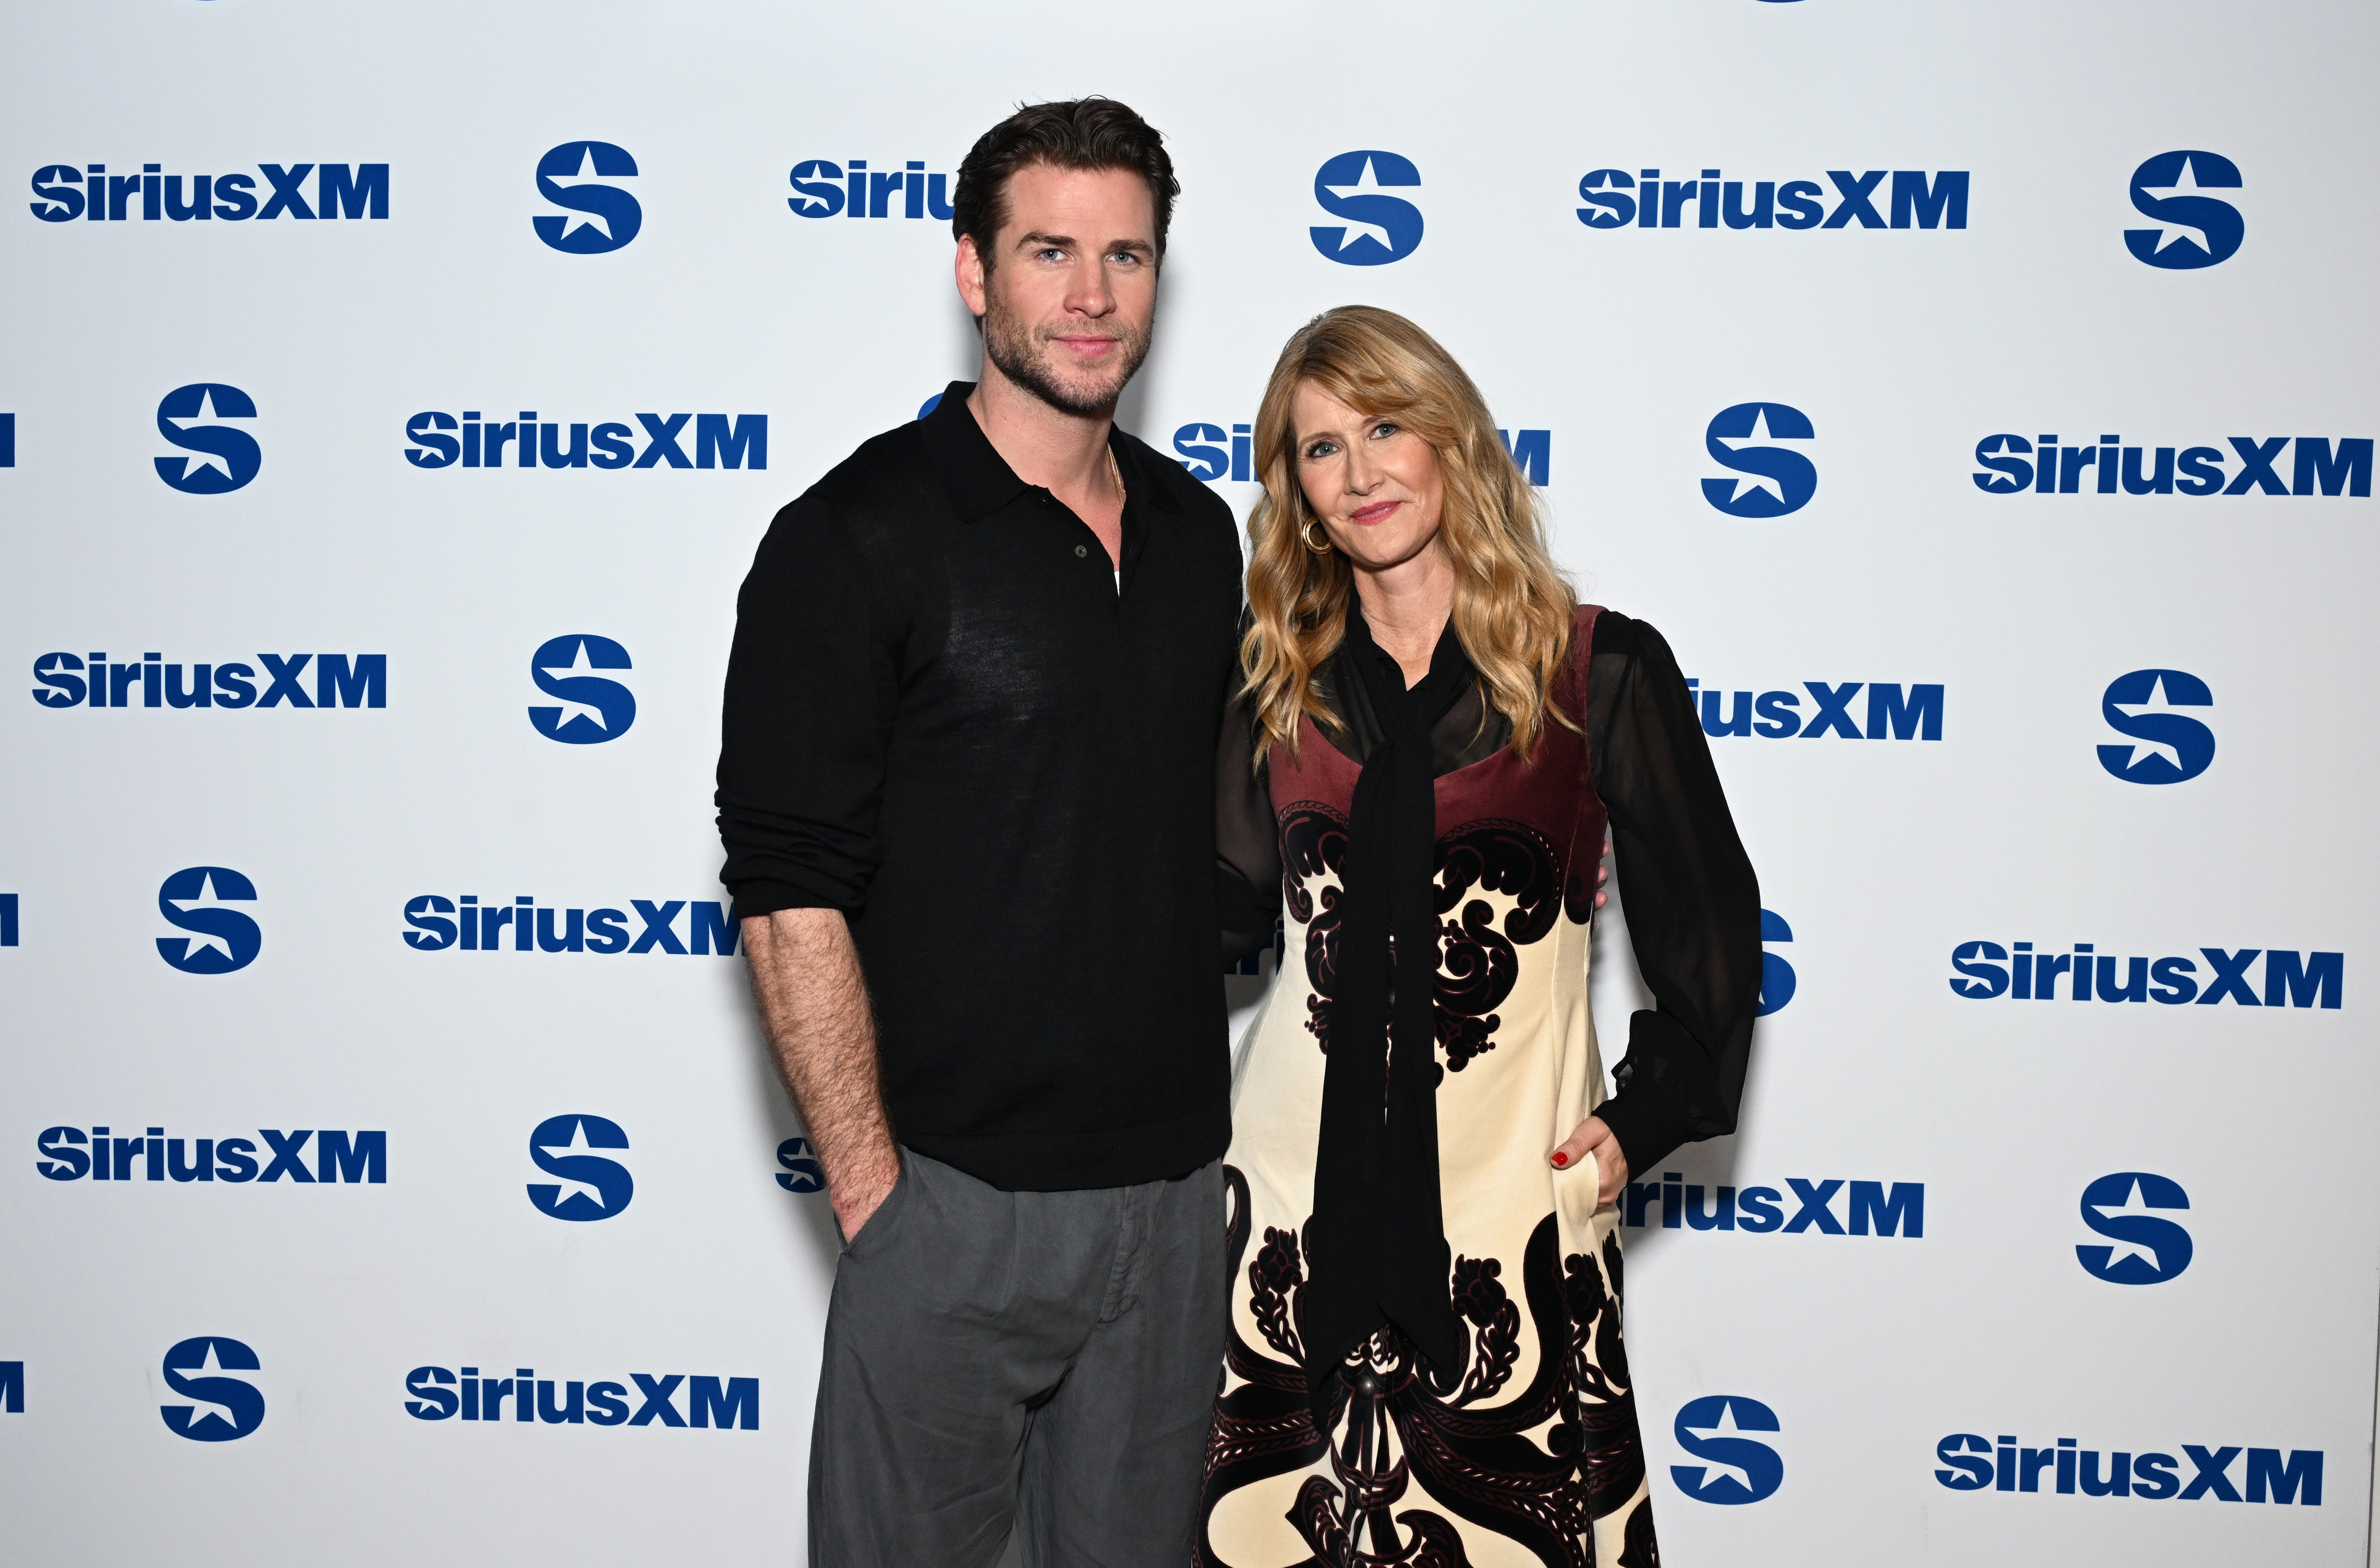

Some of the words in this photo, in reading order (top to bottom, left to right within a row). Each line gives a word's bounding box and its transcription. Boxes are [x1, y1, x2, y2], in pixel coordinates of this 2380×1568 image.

[30, 164, 389, 222] SiriusXM
[533, 141, 642, 254] S
[1309, 150, 1424, 266] S
[1577, 169, 1970, 230] SiriusXM
[2124, 150, 2244, 270] S
[154, 383, 262, 495] S
[404, 411, 768, 470] SiriusXM
[1701, 402, 1817, 518] S
[1973, 434, 2374, 497] SiriusXM
[32, 652, 386, 709] SiriusXM
[528, 634, 636, 744] S
[2097, 669, 2215, 785] S
[156, 866, 262, 974] S
[402, 895, 745, 956] SiriusXM
[1949, 941, 2344, 1009] SiriusXM
[37, 1126, 386, 1183] SiriusXM
[527, 1114, 633, 1221] S
[1616, 1172, 1924, 1238] riusXM
[2076, 1172, 2193, 1285] S
[160, 1337, 265, 1442] S
[405, 1366, 759, 1430] SiriusXM
[1670, 1395, 1784, 1505] S
[1935, 1434, 2324, 1506] SiriusXM
